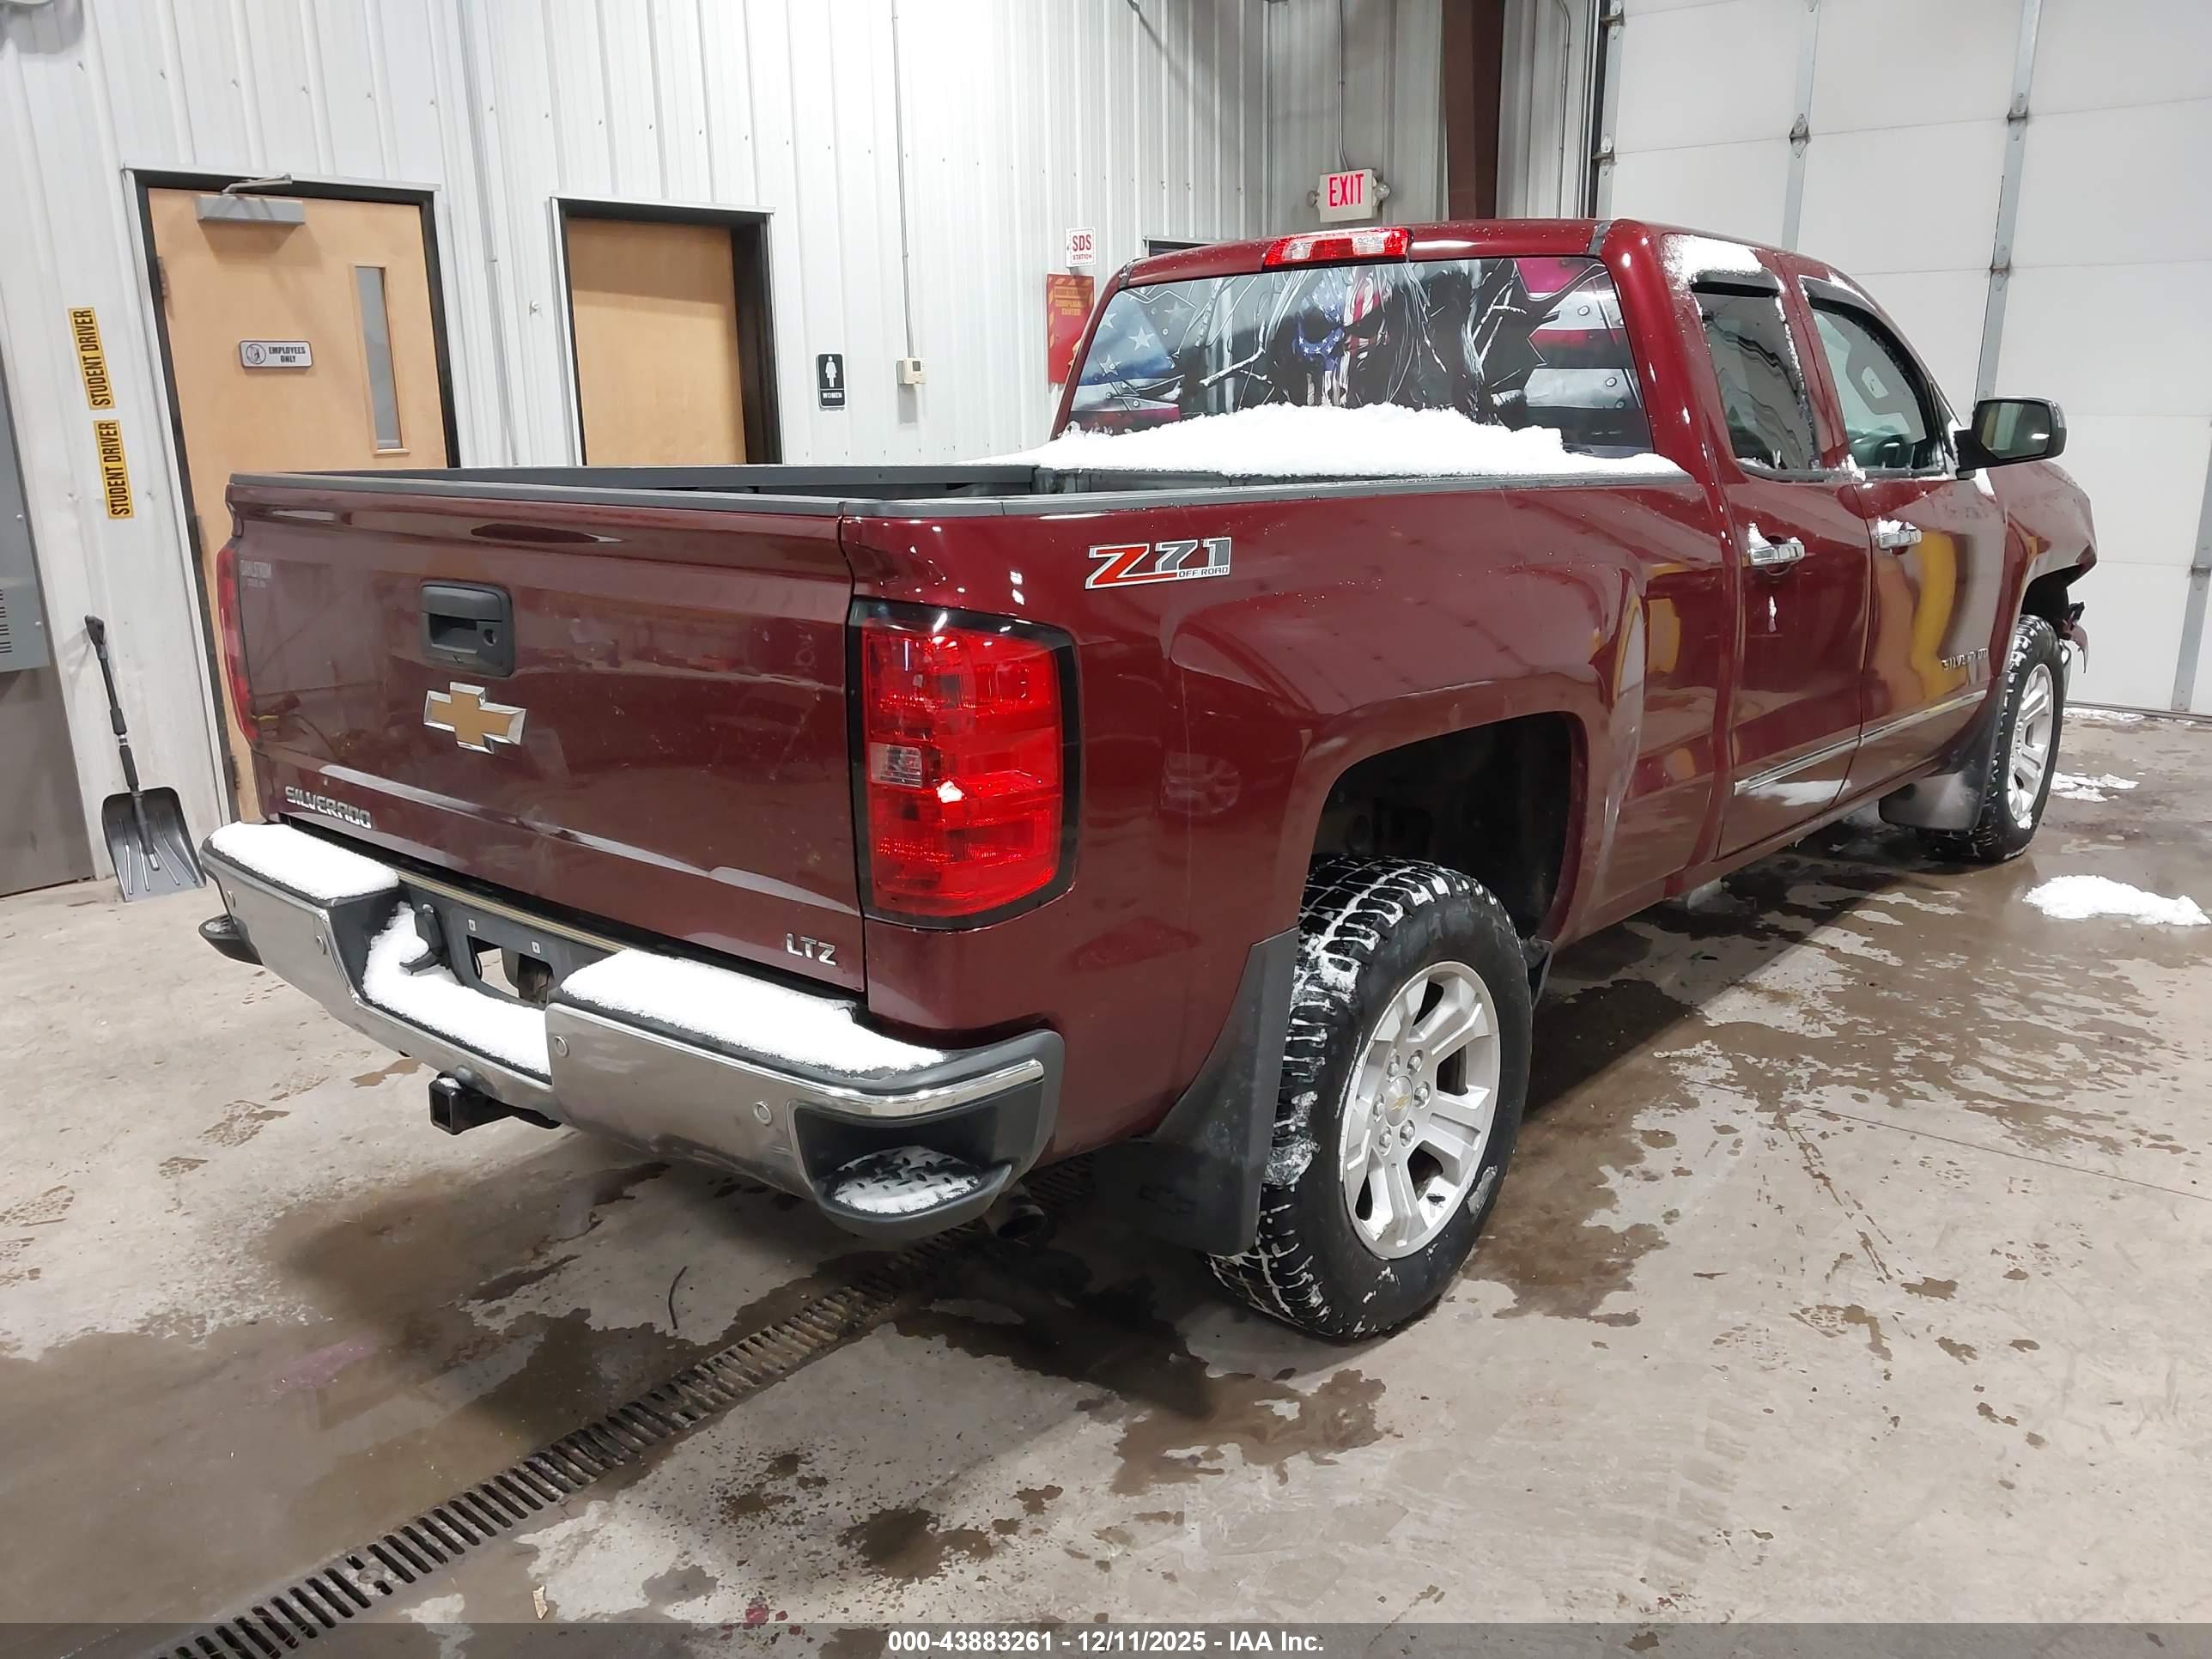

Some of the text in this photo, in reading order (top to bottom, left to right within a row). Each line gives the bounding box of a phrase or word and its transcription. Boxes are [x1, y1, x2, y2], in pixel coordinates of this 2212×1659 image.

[1329, 173, 1364, 206] EXIT
[1073, 234, 1091, 252] SDS
[73, 310, 111, 406] STUDENT DRIVER
[98, 422, 130, 515] STUDENT DRIVER
[1085, 537, 1231, 589] Z71
[1200, 566, 1229, 576] ROAD
[285, 786, 372, 829] SILVERADO
[787, 933, 837, 966] LTZ
